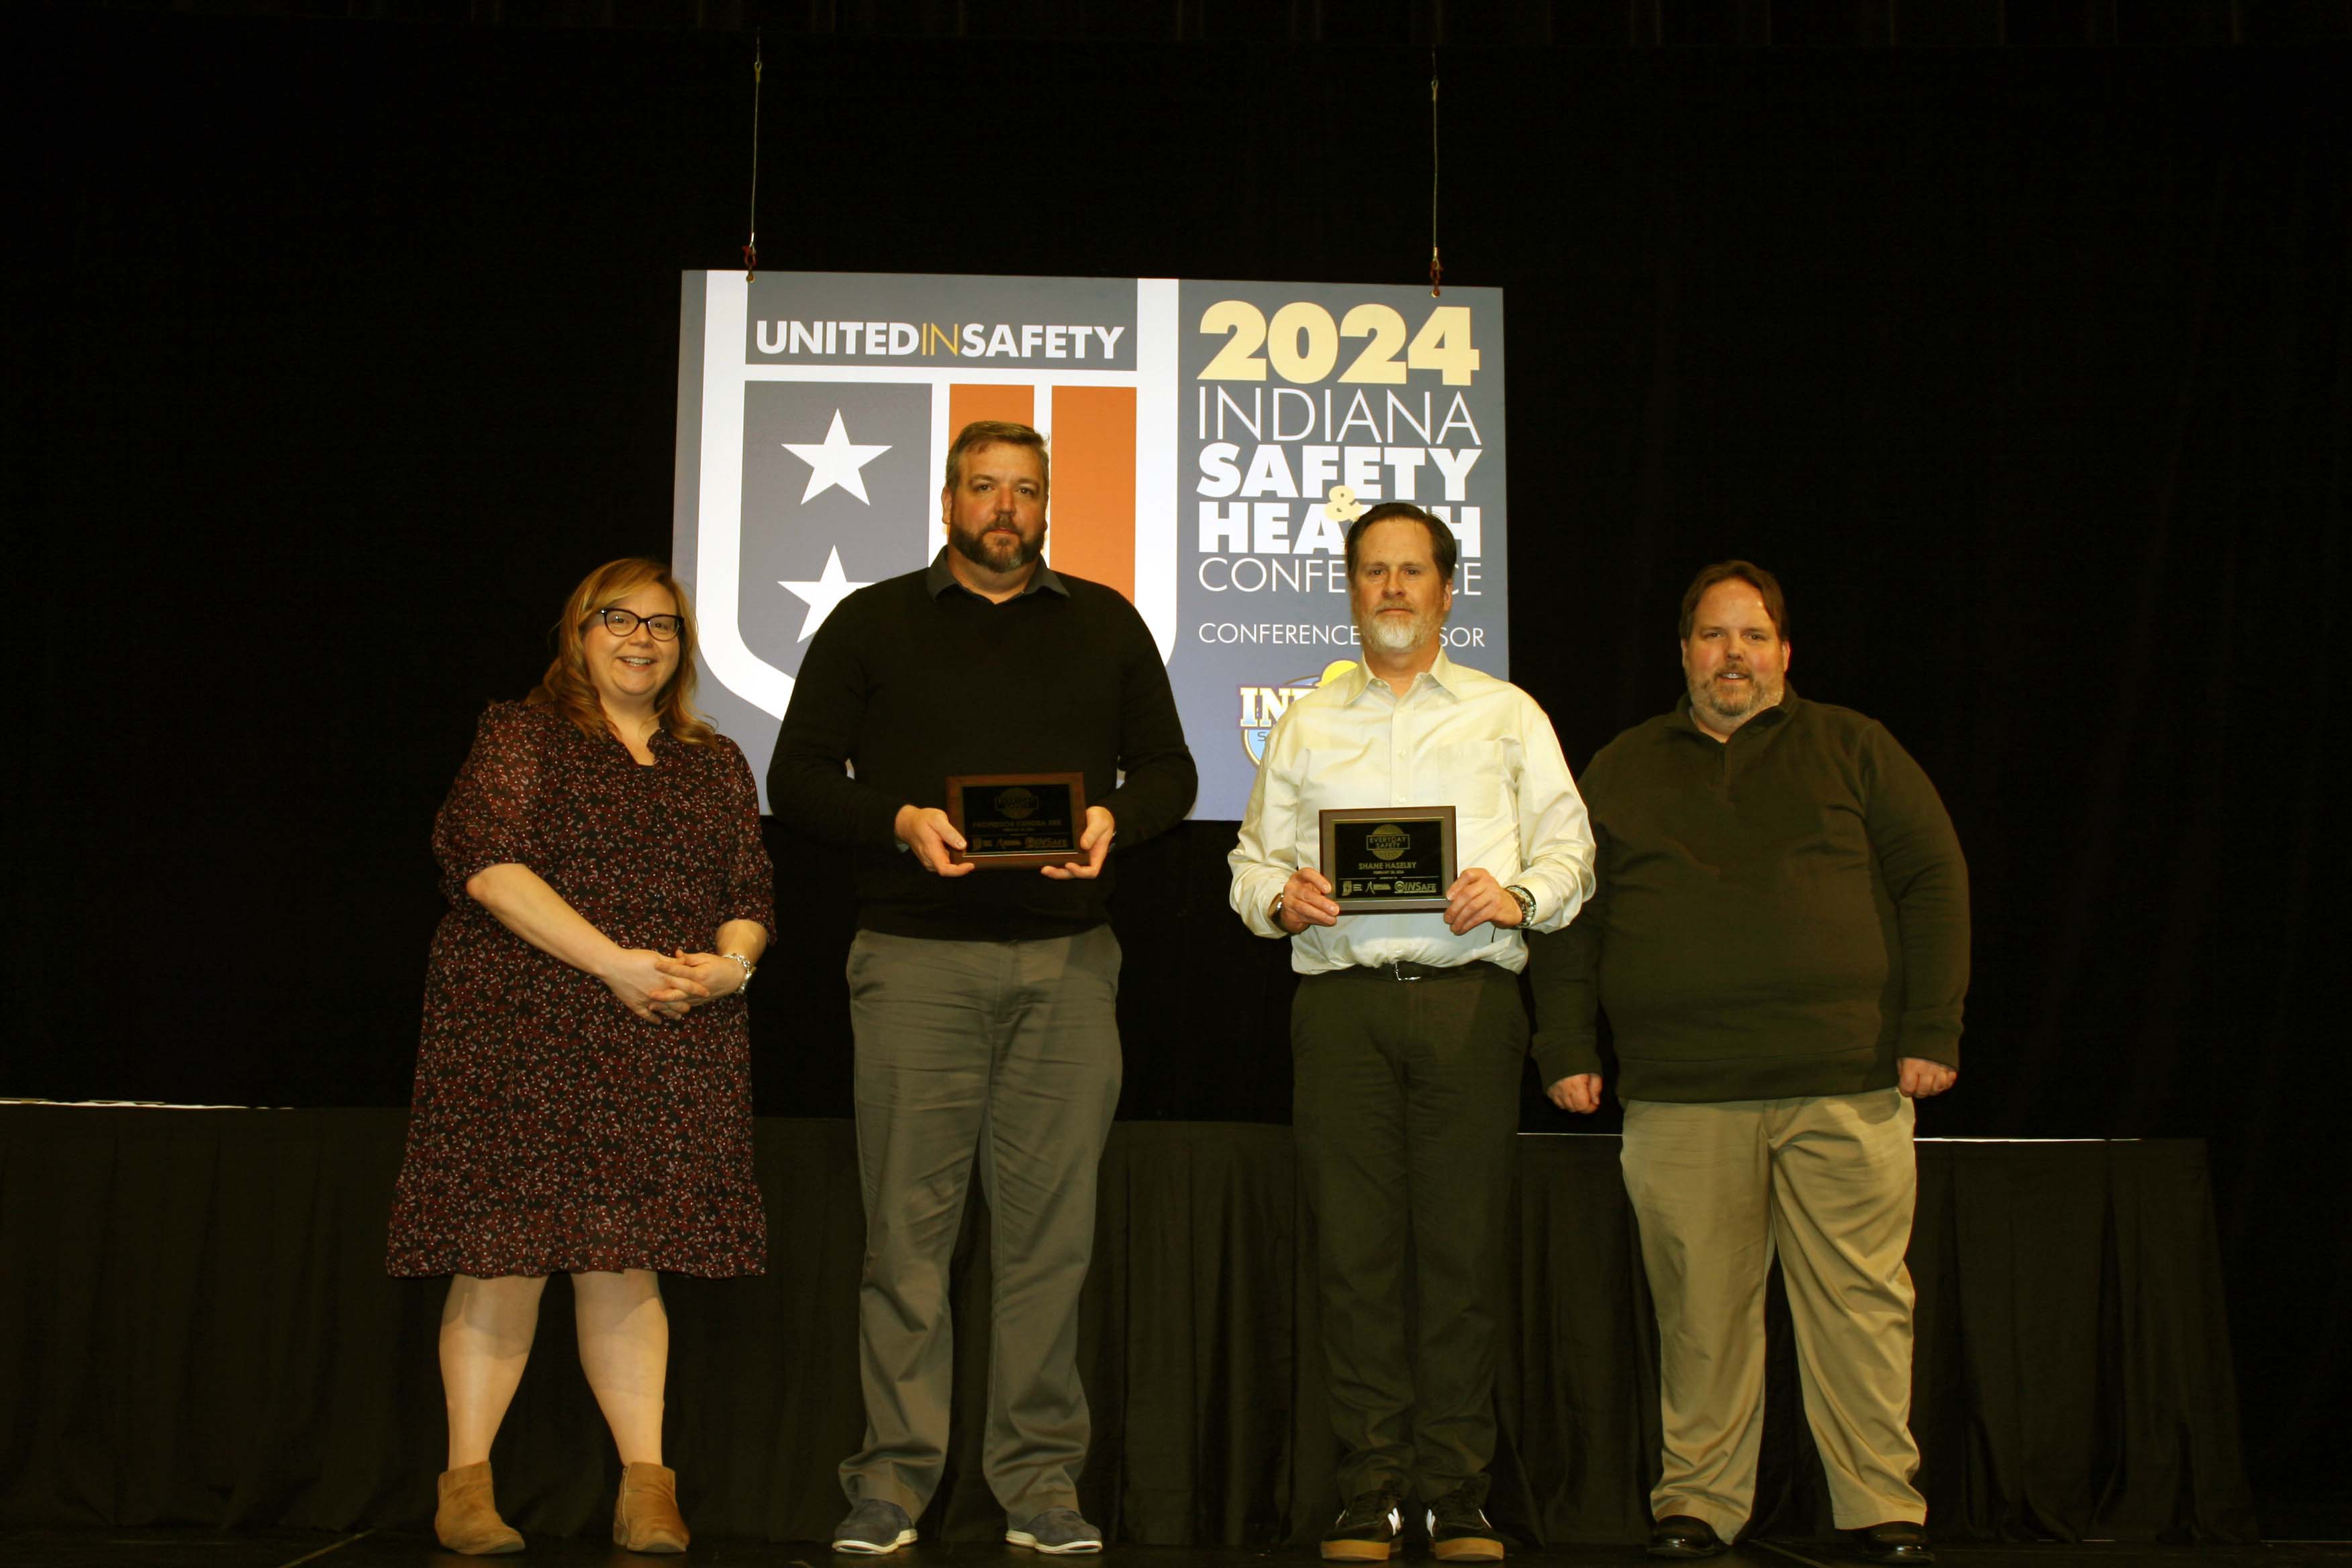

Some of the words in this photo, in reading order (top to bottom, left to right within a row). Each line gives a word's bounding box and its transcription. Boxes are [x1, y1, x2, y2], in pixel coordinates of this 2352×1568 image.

[1197, 300, 1479, 386] 2024
[1198, 385, 1482, 446] INDIANA
[1196, 442, 1482, 501] SAFETY
[1199, 501, 1481, 558] HEAH
[1199, 557, 1481, 595] CONFEE
[1199, 622, 1361, 647] CONFERENCE
